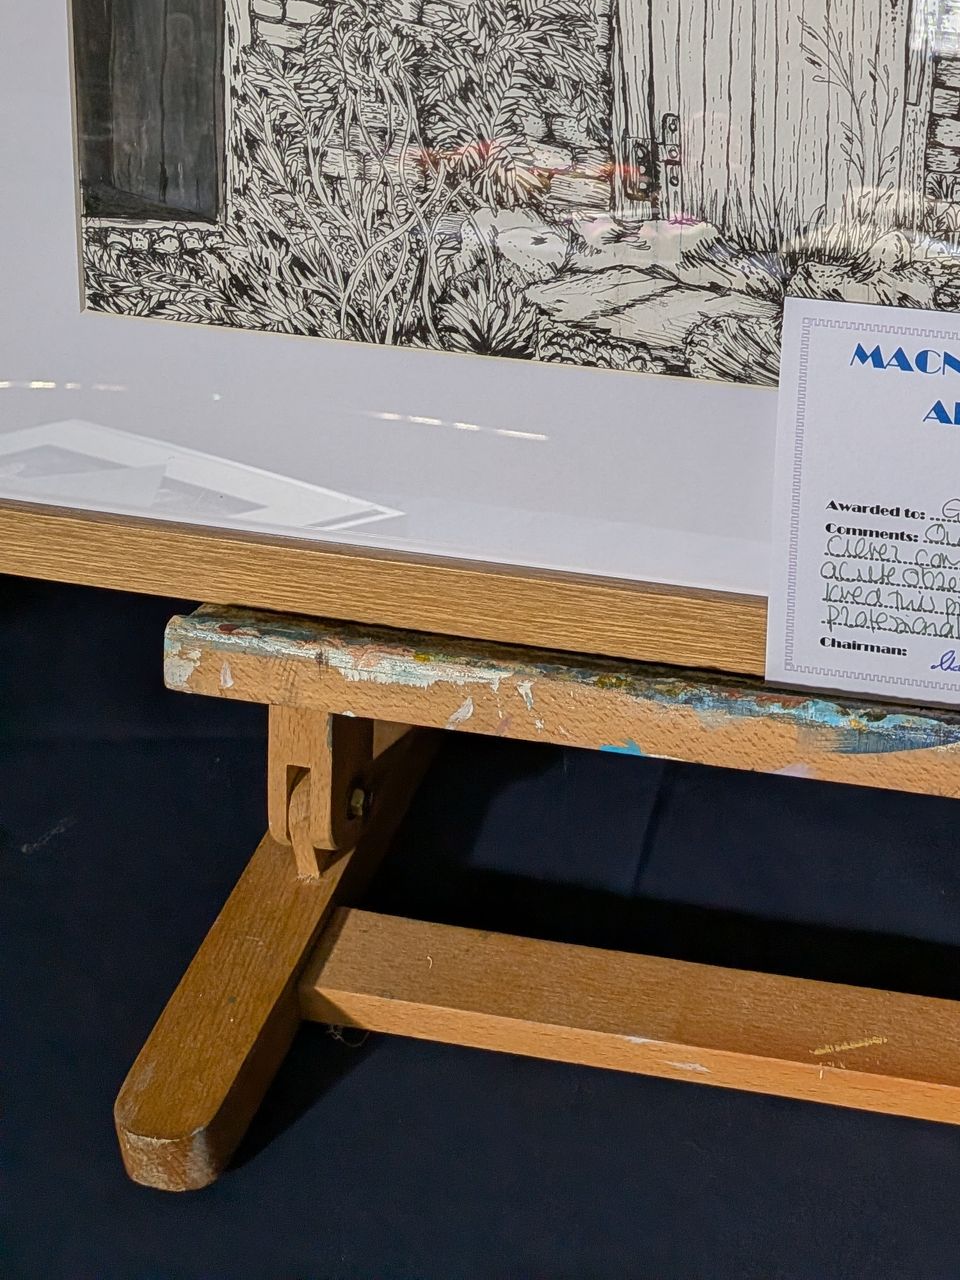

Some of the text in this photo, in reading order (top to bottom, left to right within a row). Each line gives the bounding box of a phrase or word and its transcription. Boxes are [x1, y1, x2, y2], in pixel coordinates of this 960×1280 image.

[825, 500, 926, 520] Awarded to:
[825, 522, 919, 543] Comments:
[820, 636, 907, 656] Chairman:
